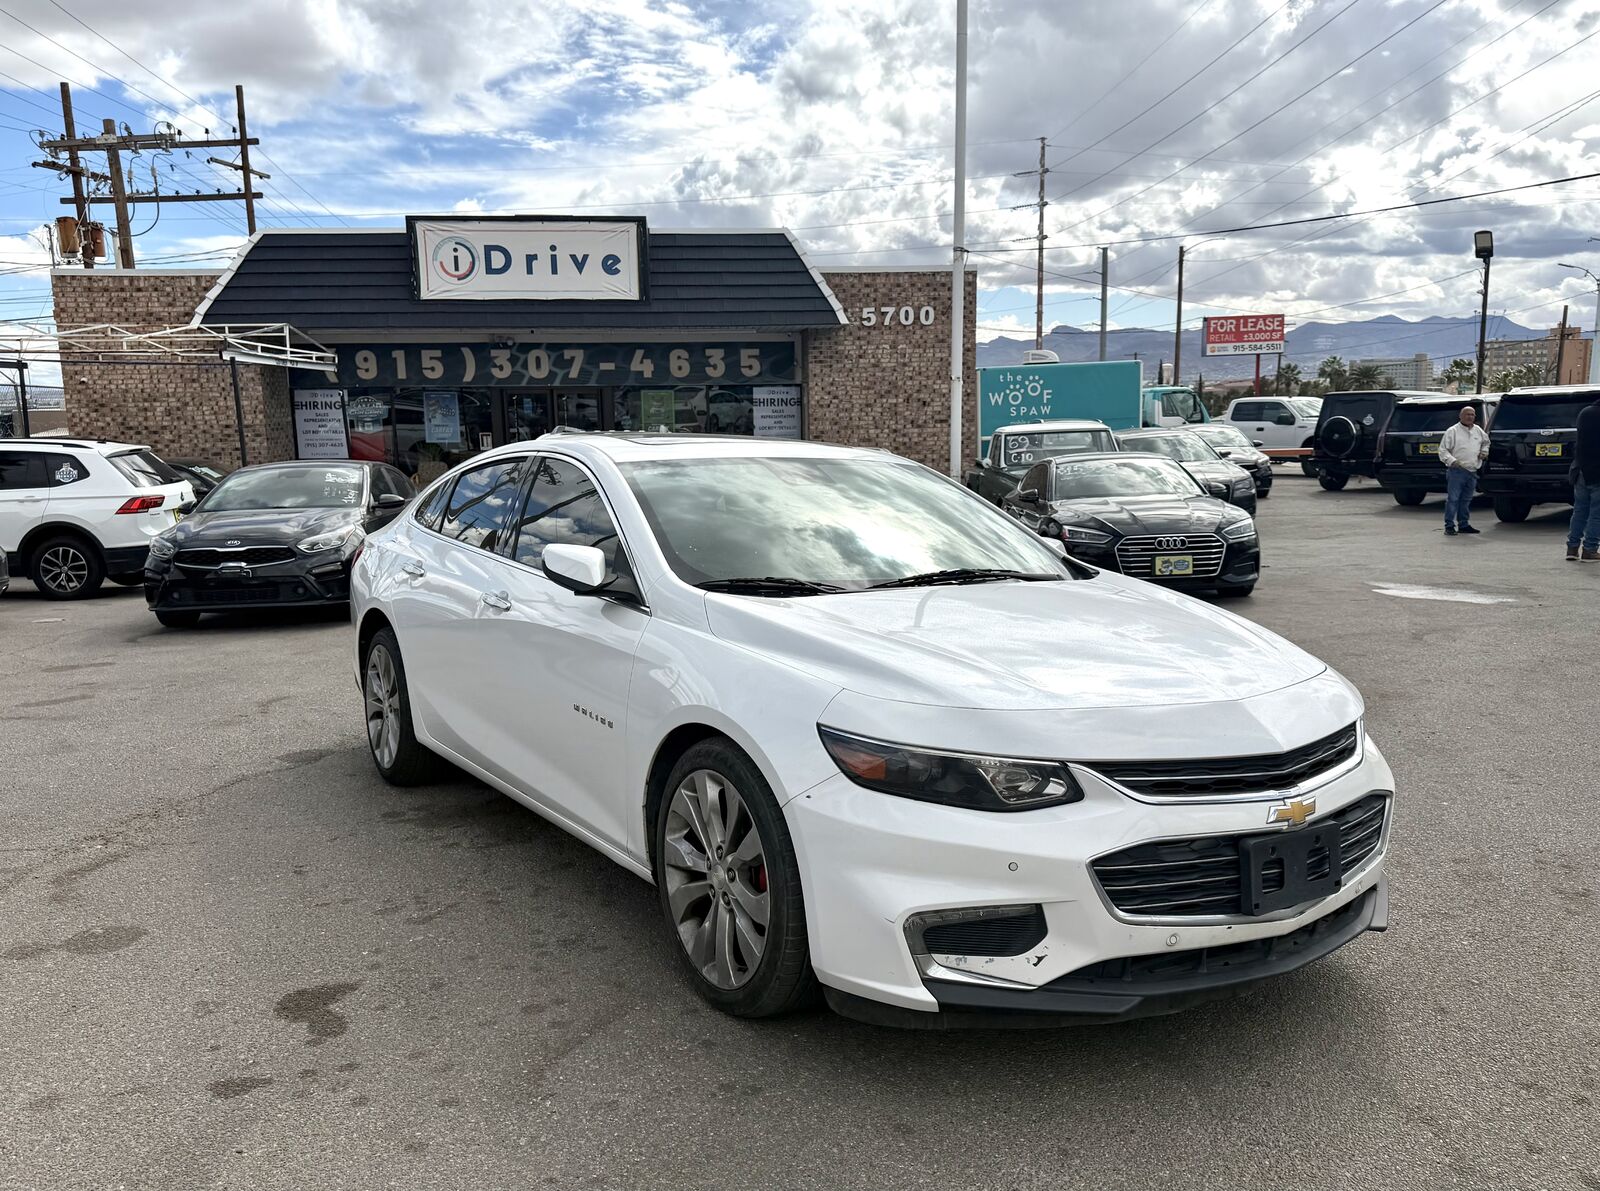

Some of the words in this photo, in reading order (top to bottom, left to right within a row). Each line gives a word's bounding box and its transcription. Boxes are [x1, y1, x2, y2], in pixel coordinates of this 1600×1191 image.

[861, 306, 935, 326] 5700
[1210, 319, 1237, 333] FOR
[1240, 318, 1282, 332] LEASE
[1209, 333, 1237, 343] RETAIL
[1271, 331, 1282, 340] SF
[1232, 343, 1282, 352] 915-584-5511
[999, 372, 1022, 382] the
[988, 382, 1053, 406] WOOF
[300, 400, 342, 411] HIRING
[758, 397, 797, 407] HIRING
[1010, 405, 1051, 416] SPAW
[1011, 452, 1034, 463] C-10
